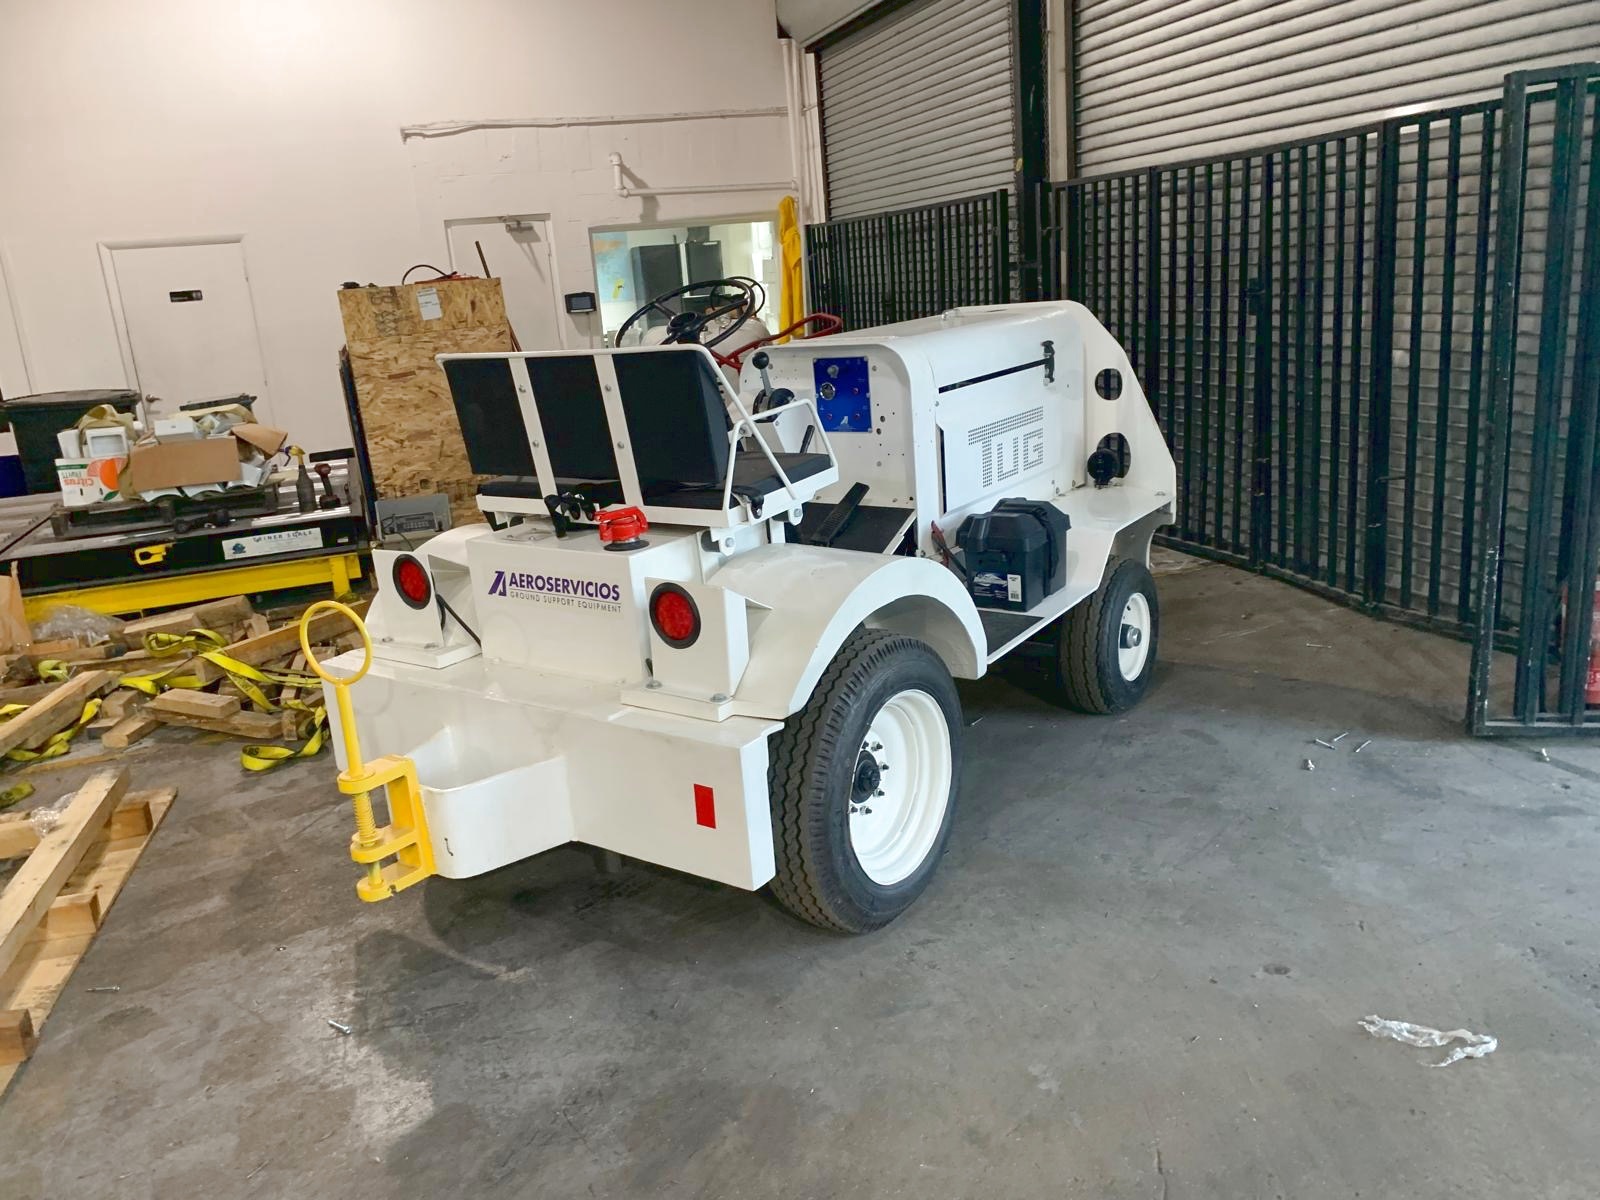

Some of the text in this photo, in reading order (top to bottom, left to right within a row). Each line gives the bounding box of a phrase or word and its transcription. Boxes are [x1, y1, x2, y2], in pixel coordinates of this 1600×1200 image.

[967, 406, 1044, 488] TUG
[63, 477, 94, 487] Citrus
[509, 572, 620, 602] AEROSERVICIOS
[510, 591, 622, 613] GROUND SUPPORT EQUIPMENT
